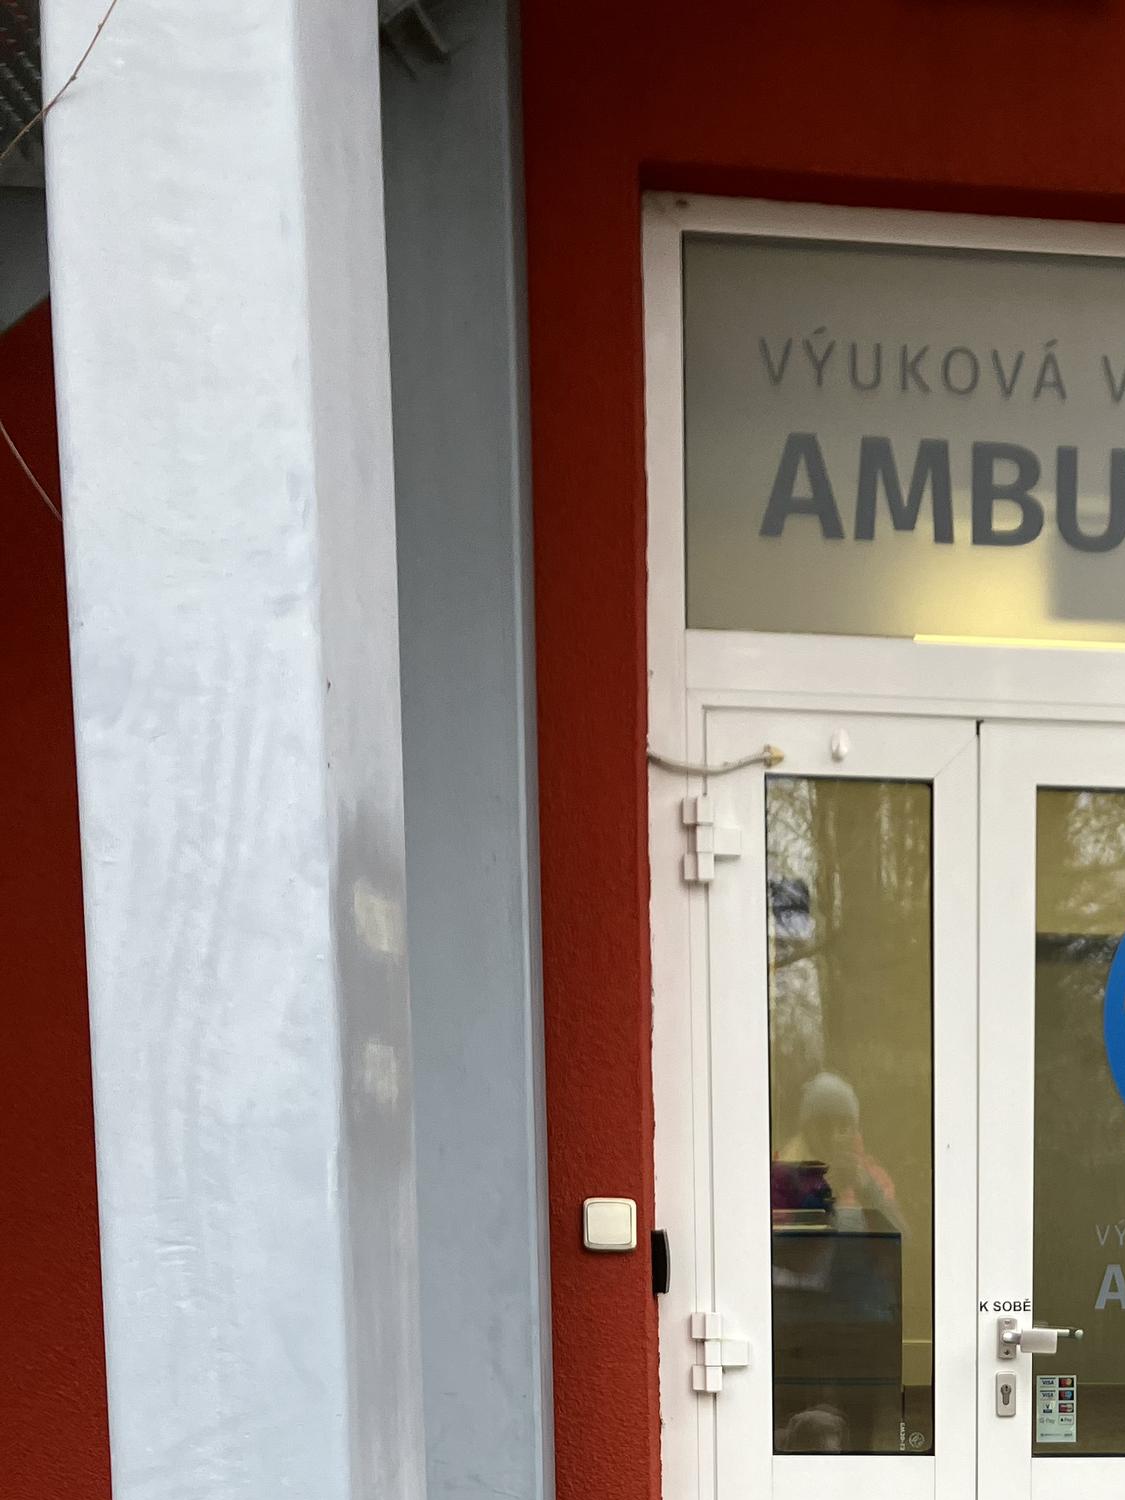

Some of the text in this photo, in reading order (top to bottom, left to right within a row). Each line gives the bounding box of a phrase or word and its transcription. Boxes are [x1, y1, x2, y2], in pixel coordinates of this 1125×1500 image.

[757, 326, 1067, 400] VÝUKOVÁ
[979, 1298, 1032, 1312] K SOBĚ
